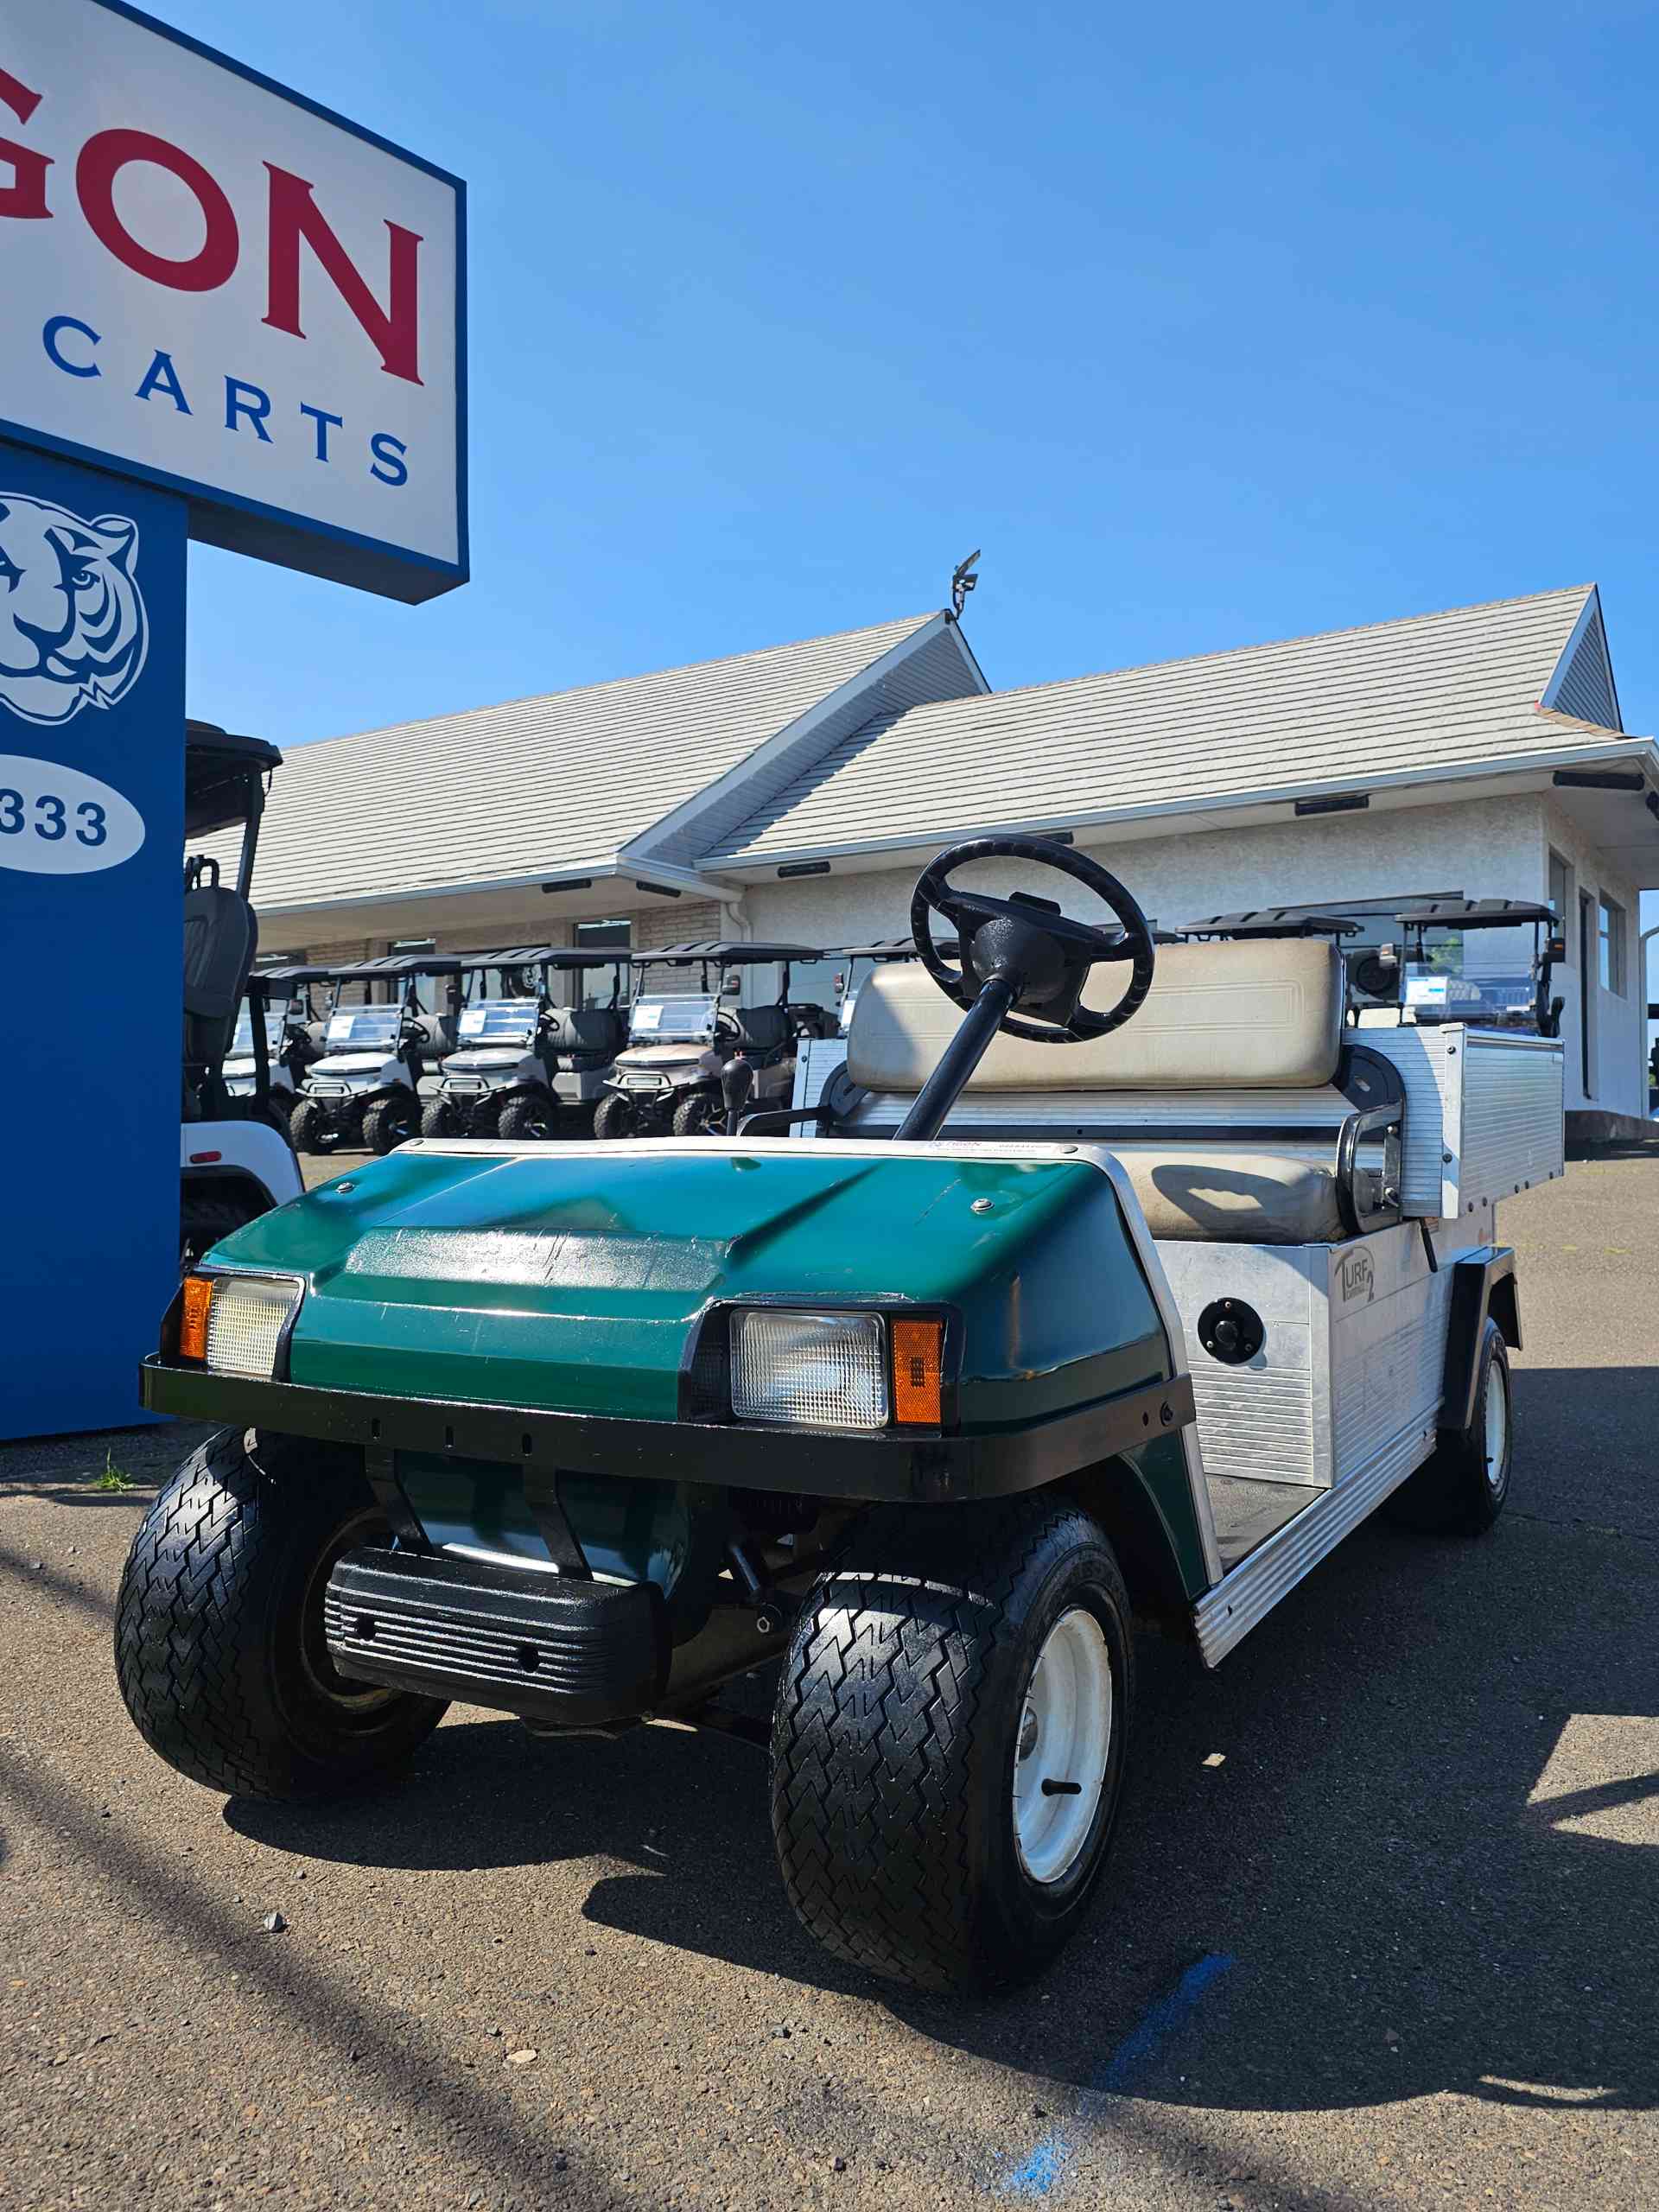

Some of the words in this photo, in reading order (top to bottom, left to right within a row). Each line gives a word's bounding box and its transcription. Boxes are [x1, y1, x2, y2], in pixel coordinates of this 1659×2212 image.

[42, 315, 409, 487] CARTS
[0, 788, 107, 847] 333
[1334, 1249, 1368, 1302] TURF
[1366, 1270, 1375, 1303] 2
